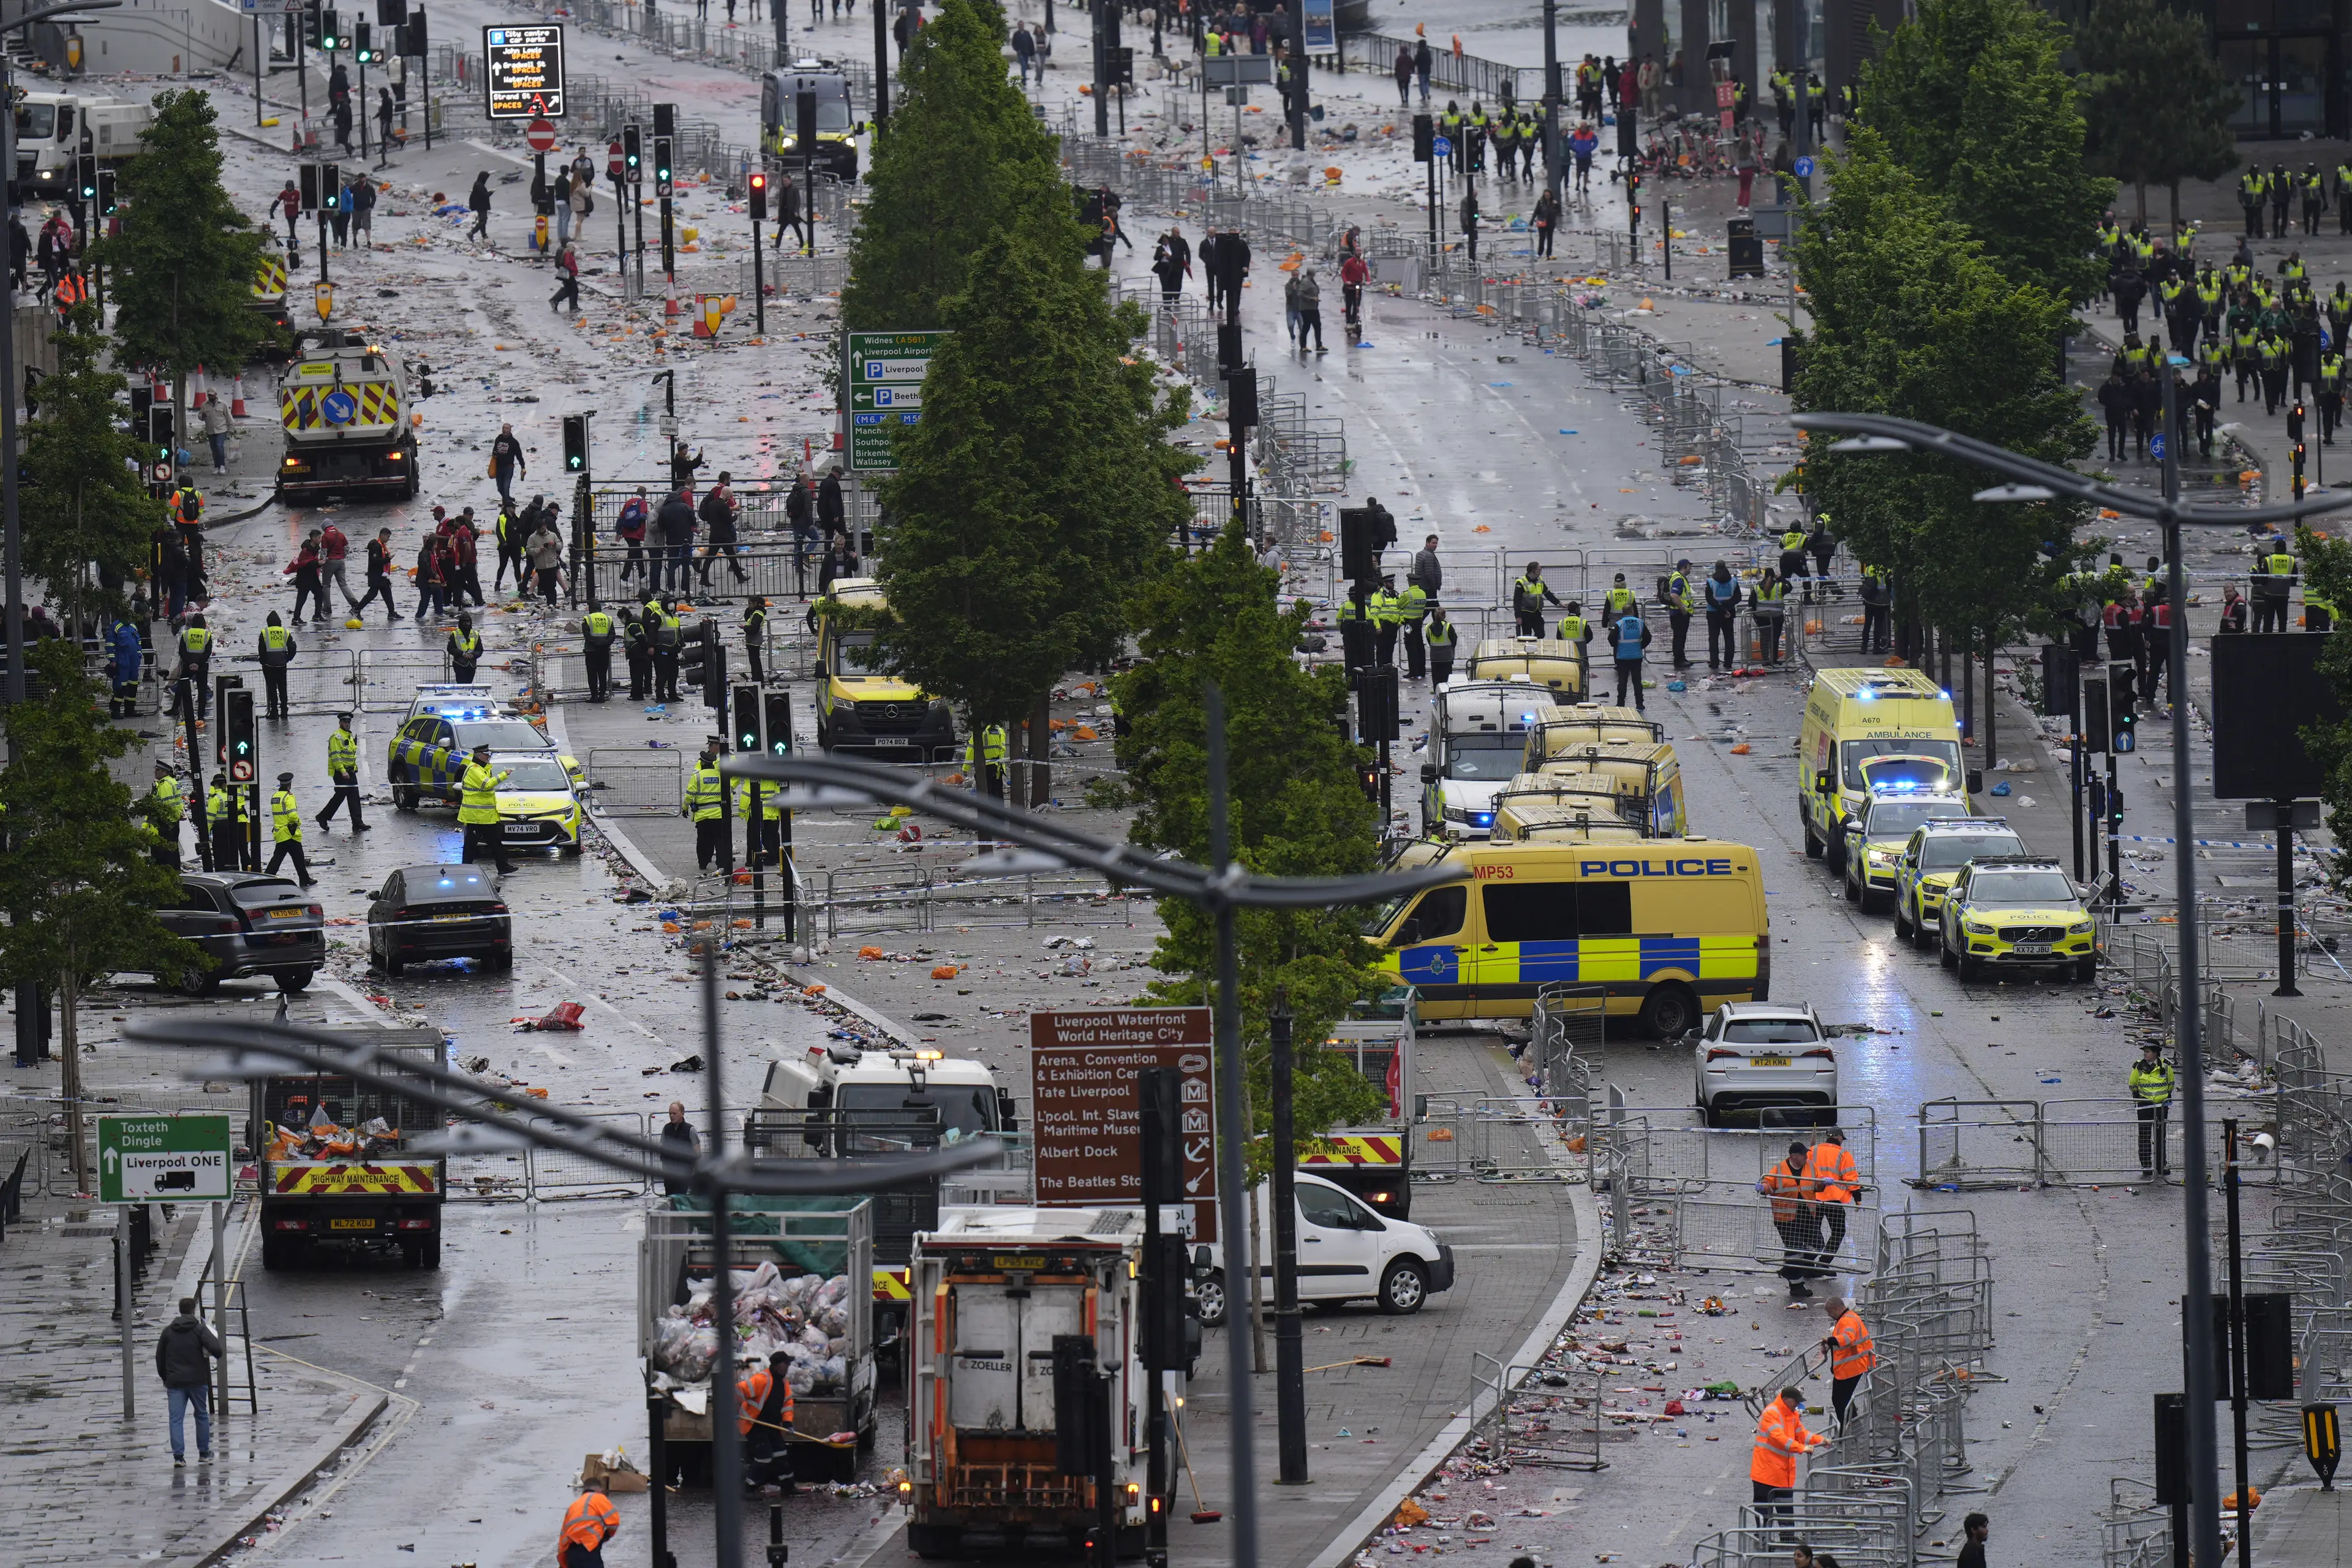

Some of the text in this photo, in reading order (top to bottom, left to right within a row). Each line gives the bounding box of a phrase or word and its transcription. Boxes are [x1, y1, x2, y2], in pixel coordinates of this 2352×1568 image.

[864, 348, 902, 356] Liverpool
[885, 366, 923, 374] Liverpool
[1473, 865, 1513, 880] MP53
[1580, 859, 1732, 876] POLICE
[1054, 1013, 1186, 1028] Liverpool Waterfront
[1057, 1028, 1183, 1042] World Heritage City
[1085, 1053, 1157, 1065] Convention
[1037, 1070, 1046, 1080] &
[1050, 1069, 1112, 1080] Exhibition
[1037, 1085, 1130, 1098] Tate Liverpool
[1107, 1109, 1140, 1120] Slave
[121, 1122, 168, 1133] Toxteth
[1044, 1123, 1140, 1136] Maritime Muse
[121, 1136, 163, 1150] Dingle
[1039, 1145, 1118, 1158] Albert Dock
[127, 1156, 221, 1169] Liverpool ONE
[312, 1174, 399, 1185] HIGHWAY MAINTENANCE
[1039, 1175, 1141, 1188] The Beatles Sto
[970, 1360, 1012, 1373] ZOELLER
